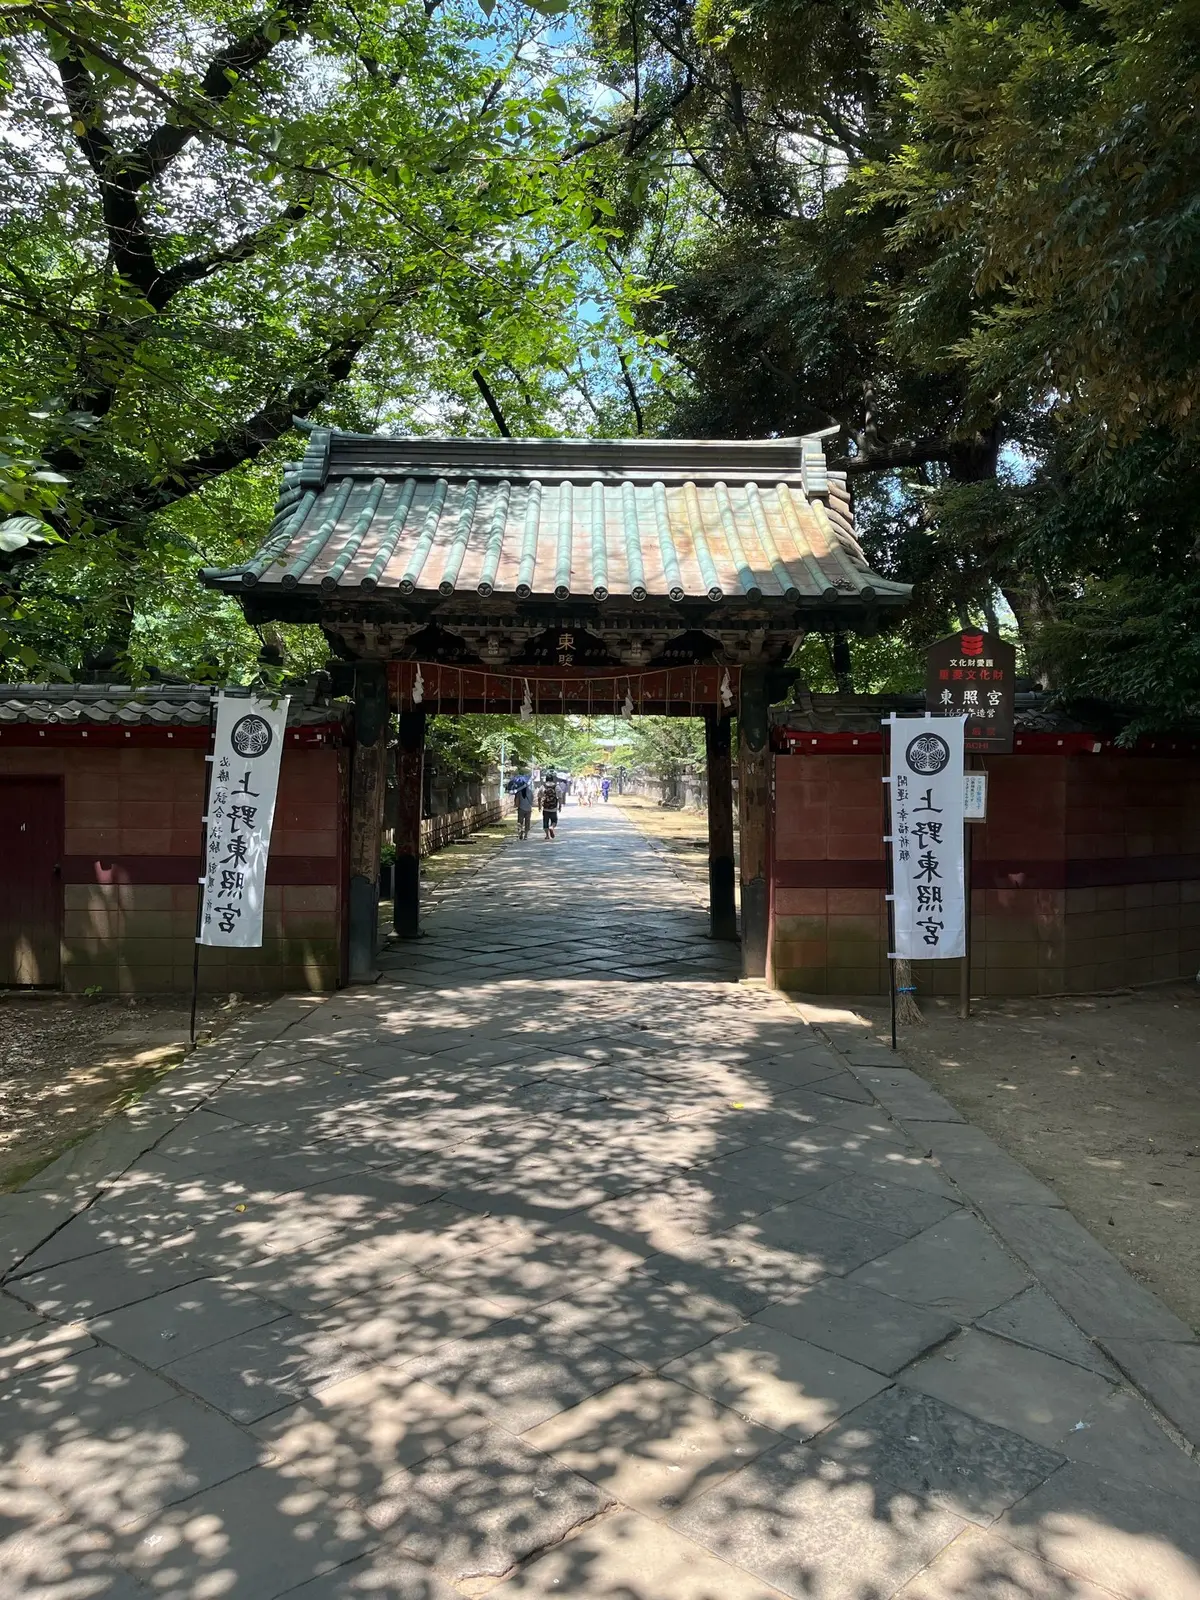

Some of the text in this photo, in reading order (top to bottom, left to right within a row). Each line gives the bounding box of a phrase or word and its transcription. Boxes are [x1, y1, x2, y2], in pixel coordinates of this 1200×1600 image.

[949, 658, 994, 667] 文化財愛護
[939, 669, 1004, 681] 重要文化財
[939, 688, 1003, 706] 東照宮
